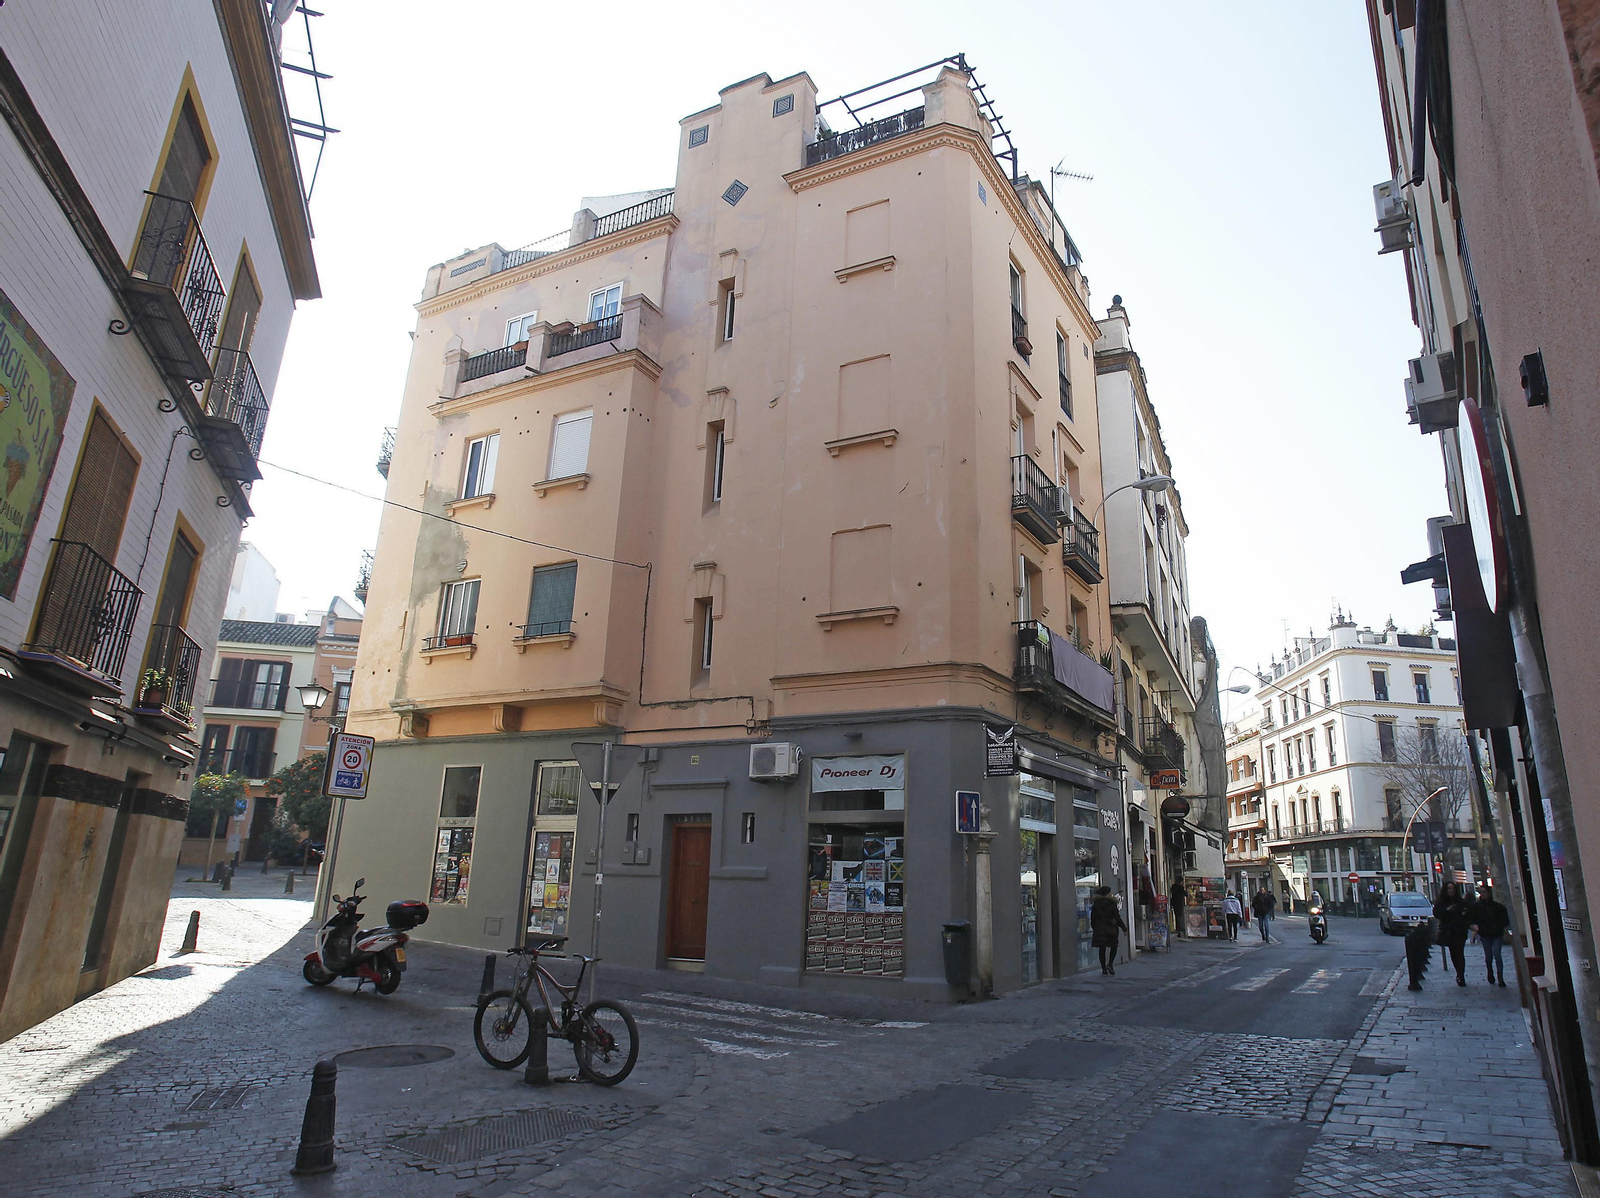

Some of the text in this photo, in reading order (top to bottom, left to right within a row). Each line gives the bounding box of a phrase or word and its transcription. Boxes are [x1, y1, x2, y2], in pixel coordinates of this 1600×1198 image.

[346, 755, 358, 764] 20
[820, 765, 897, 779] Pioneer DJ
